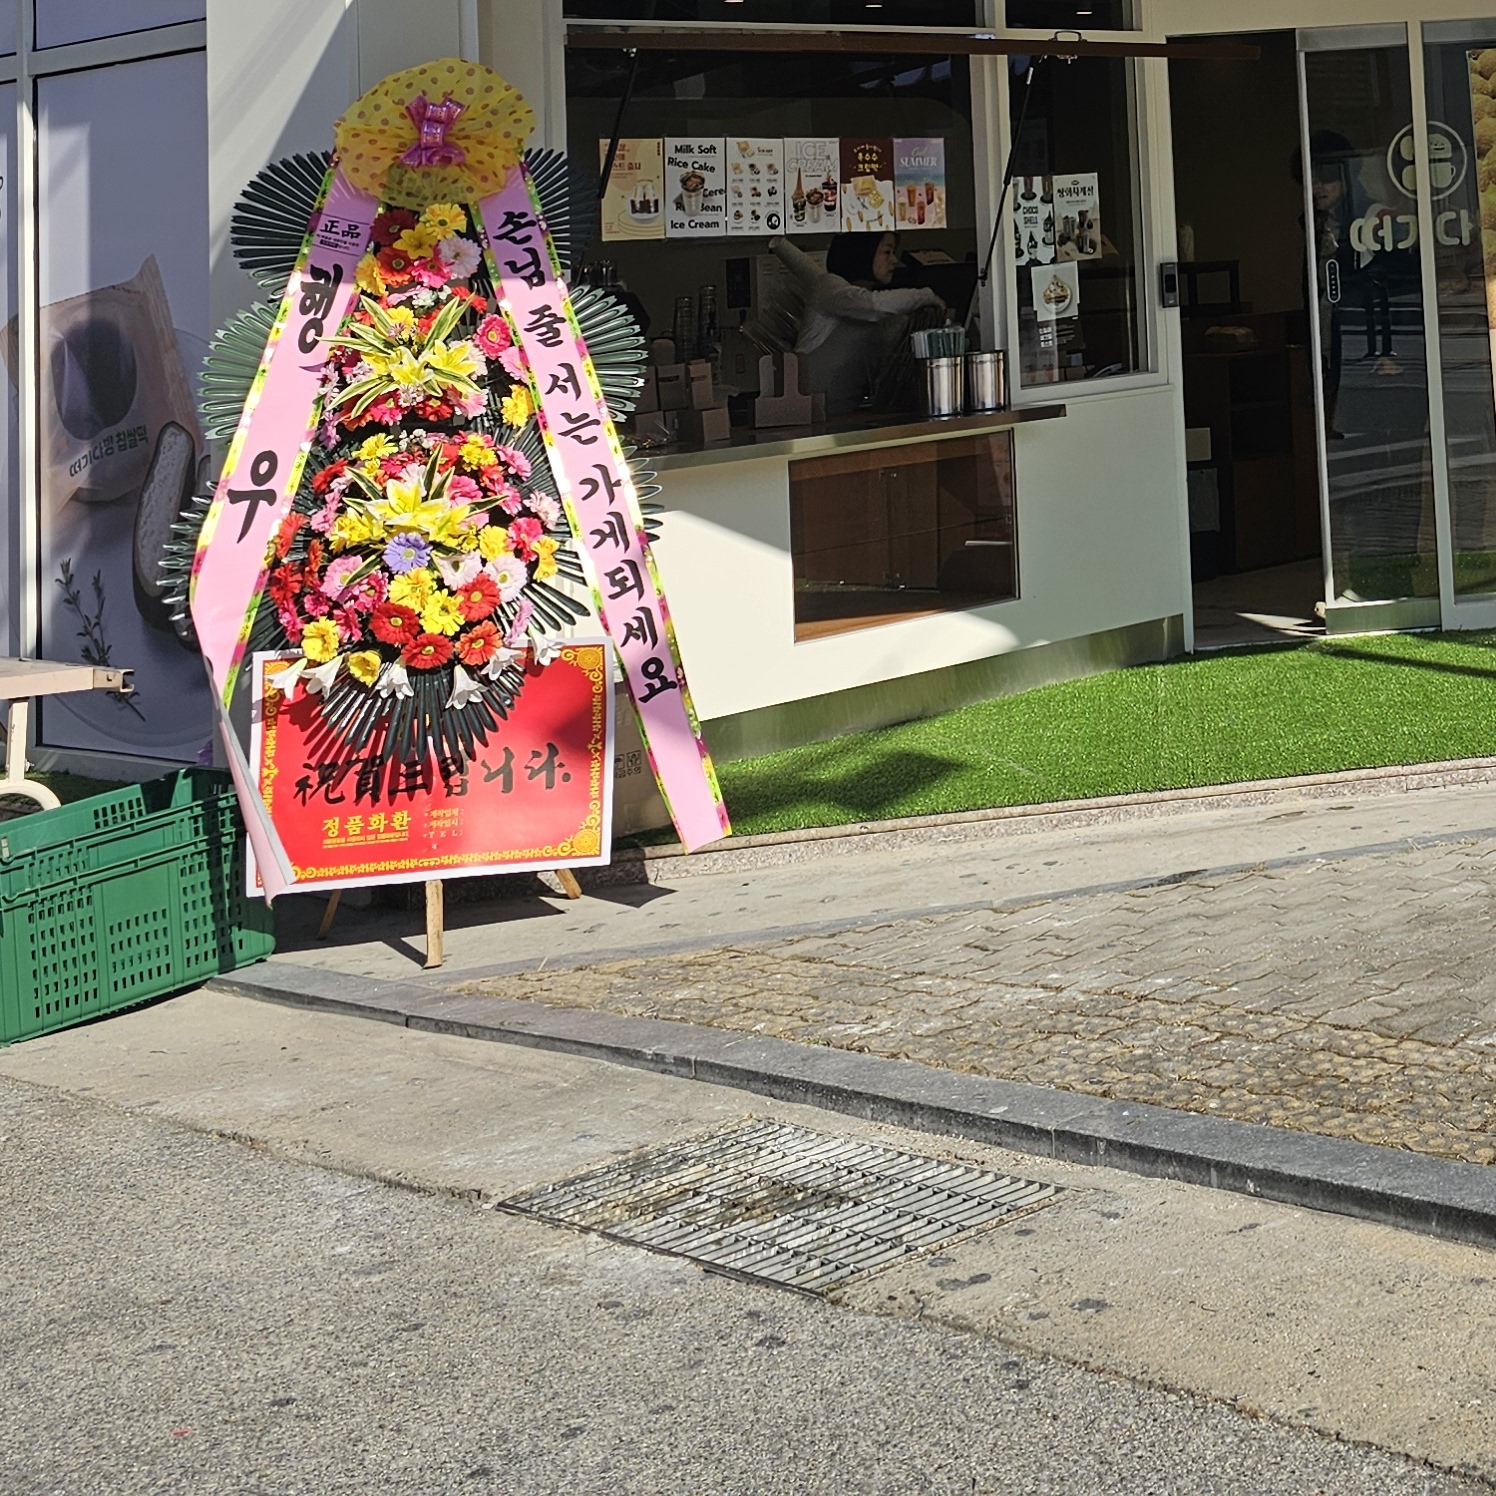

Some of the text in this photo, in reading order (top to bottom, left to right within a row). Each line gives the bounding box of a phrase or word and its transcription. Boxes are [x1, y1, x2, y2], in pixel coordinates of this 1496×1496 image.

[674, 144, 717, 155] Milk Soft
[795, 141, 826, 160] ICE
[667, 156, 716, 174] Rice Cake
[786, 158, 838, 174] CREAM
[900, 157, 938, 168] SUMMER
[1022, 205, 1039, 215] CHOCO
[319, 219, 362, 240] 正品
[670, 219, 720, 230] Ice Cream
[321, 810, 412, 838] 정품화환
